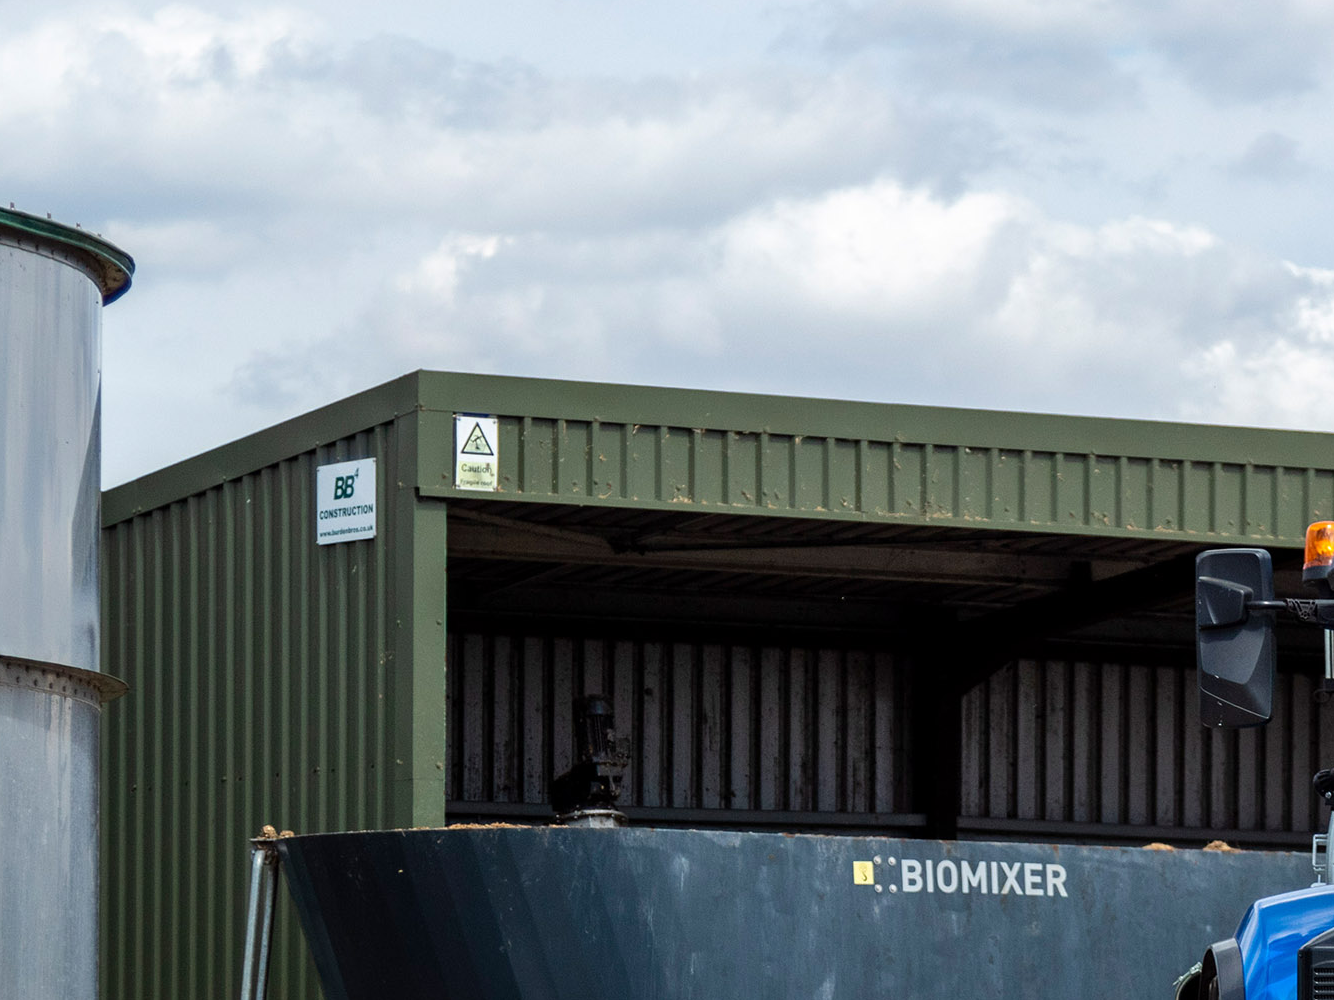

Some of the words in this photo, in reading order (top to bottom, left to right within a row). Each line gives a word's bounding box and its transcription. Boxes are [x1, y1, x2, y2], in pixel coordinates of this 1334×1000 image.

[461, 463, 492, 474] Caution
[319, 504, 374, 520] CONSTRUCTION
[901, 859, 1068, 897] BIOMIXER
